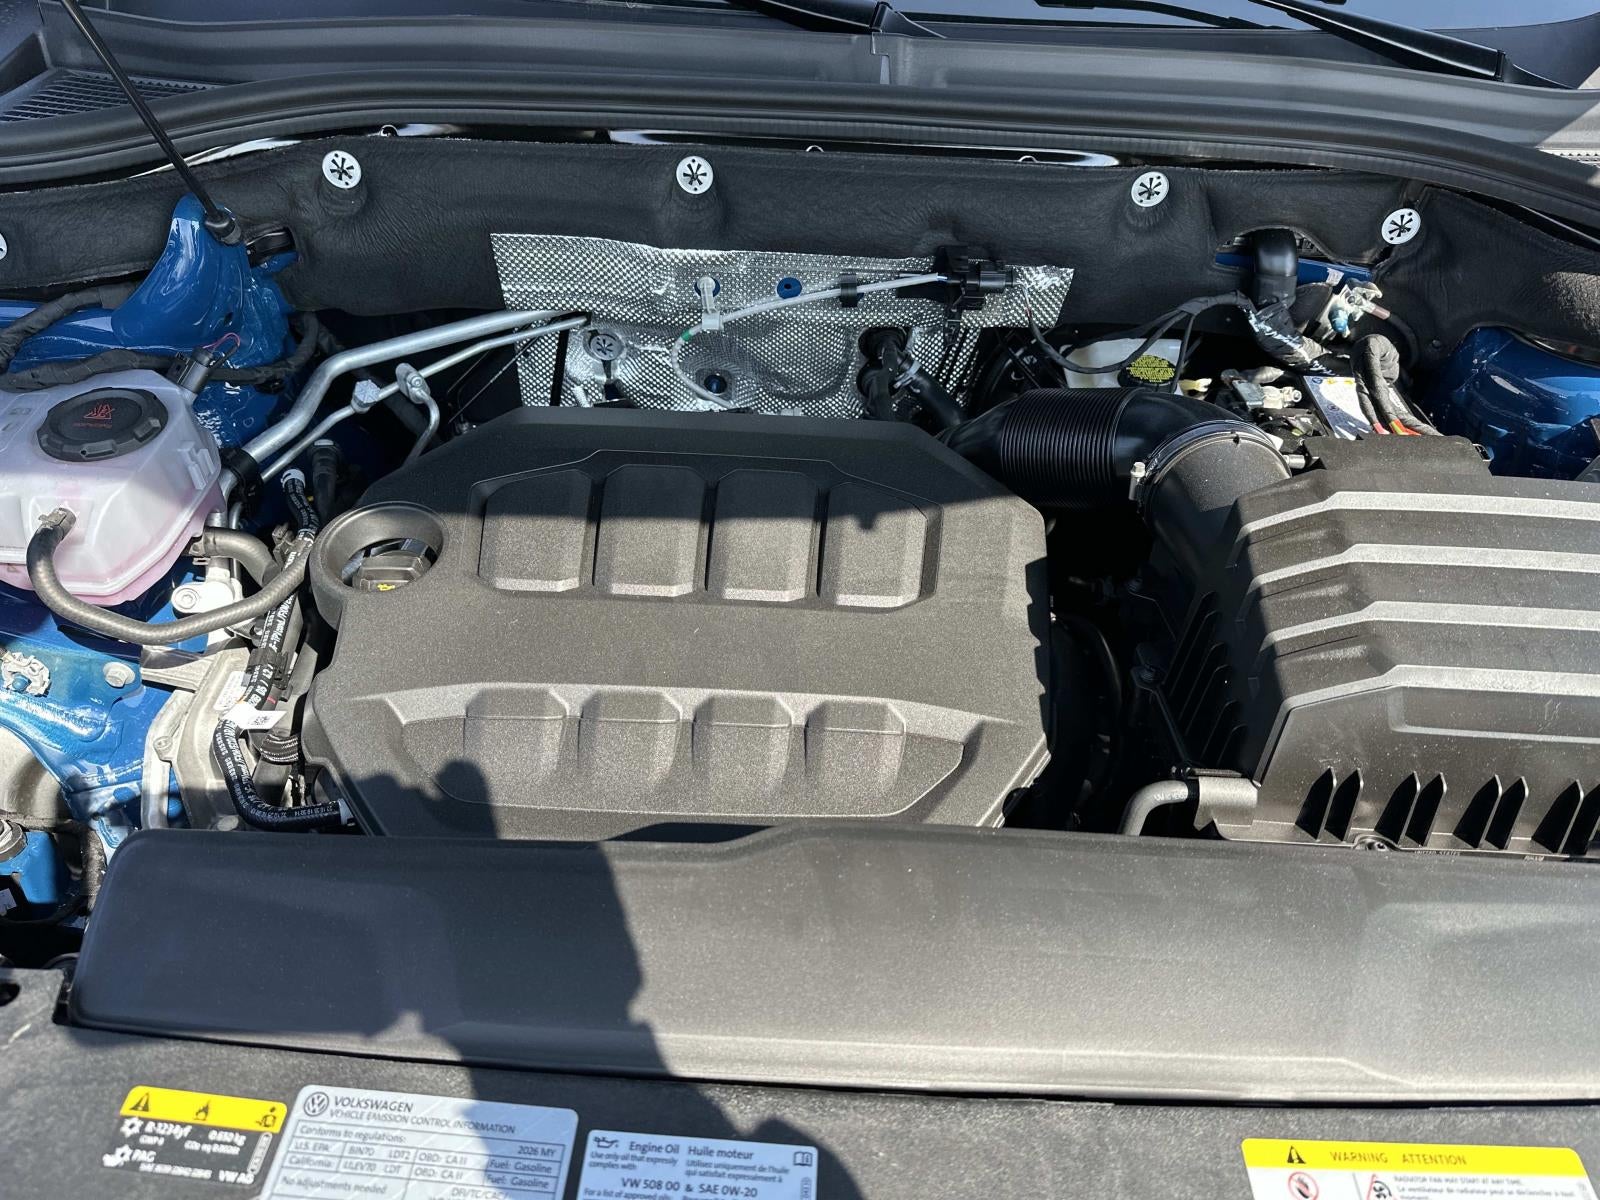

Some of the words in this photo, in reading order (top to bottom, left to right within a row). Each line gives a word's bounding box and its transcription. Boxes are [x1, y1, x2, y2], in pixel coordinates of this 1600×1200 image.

[334, 1096, 414, 1113] VOLKSWAGEN
[330, 1108, 363, 1120] VEHICLE
[367, 1112, 409, 1124] EMISSION
[411, 1117, 451, 1129] CONTROL
[453, 1120, 516, 1134] INFORMATION
[300, 1125, 342, 1138] Conforms
[344, 1130, 352, 1138] to
[355, 1131, 407, 1144] regulations:
[517, 1144, 539, 1156] 2026
[541, 1146, 557, 1157] MY
[590, 1151, 604, 1159] Use
[605, 1153, 621, 1162] only
[631, 1154, 644, 1162] that
[646, 1157, 678, 1167] expressly
[629, 1141, 664, 1154] Engine
[665, 1144, 680, 1154] Oil
[688, 1146, 715, 1157] Huile
[716, 1149, 755, 1160] moteur
[1330, 1151, 1389, 1164] WARNING
[1402, 1153, 1467, 1166] ATTENTION
[348, 1146, 375, 1156] BIN70
[389, 1149, 411, 1160] LDT2
[418, 1152, 441, 1164] OBD:
[445, 1156, 459, 1165] CA
[489, 1159, 510, 1170] Fuel:
[514, 1161, 552, 1174] Gasoline
[588, 1161, 619, 1171] complies
[621, 1163, 637, 1171] with
[686, 1159, 713, 1168] Utilisez
[714, 1161, 757, 1172] uniquement
[758, 1164, 767, 1173] de
[219, 1170, 238, 1183] VW
[236, 1172, 255, 1185] AG
[414, 1166, 438, 1178] OBD:
[441, 1169, 455, 1180] CA
[487, 1174, 508, 1185] Fuel:
[511, 1176, 550, 1189] Gasoline
[685, 1168, 698, 1177] qui
[698, 1169, 726, 1179] satisfait
[296, 1177, 351, 1192] adjustments
[353, 1181, 388, 1195] needed
[622, 1177, 642, 1188] VW
[643, 1179, 662, 1190] 508
[665, 1181, 681, 1192] 00
[685, 1184, 693, 1193] &
[699, 1184, 719, 1194] SAE
[721, 1186, 758, 1198] 0W-20
